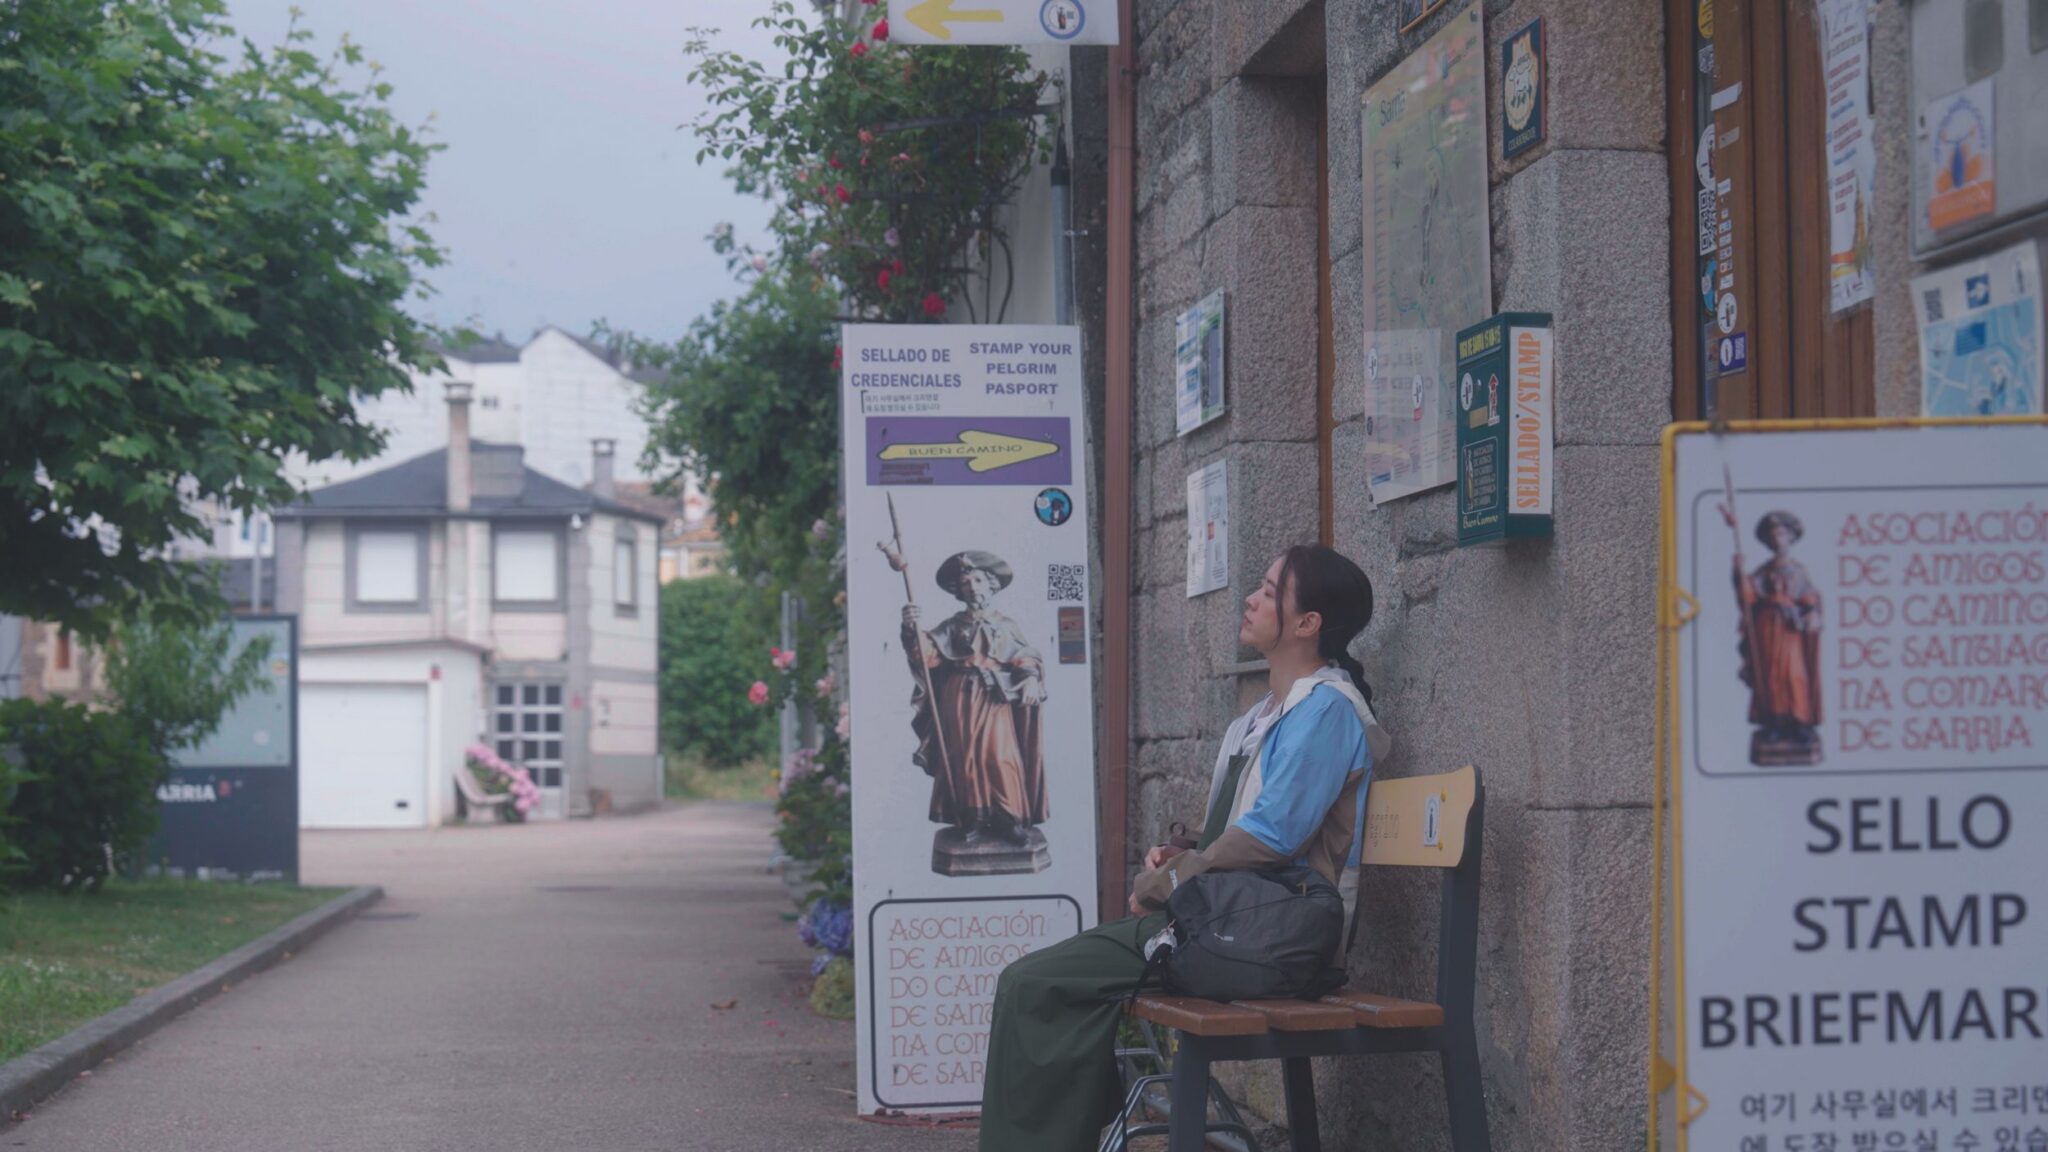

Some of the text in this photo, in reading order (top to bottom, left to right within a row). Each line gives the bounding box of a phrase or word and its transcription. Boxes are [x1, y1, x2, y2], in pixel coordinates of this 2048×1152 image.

[861, 348, 951, 363] SELLADO DE
[970, 342, 1072, 356] STAMP YOUR
[851, 373, 962, 389] CREDENCIALES
[986, 362, 1057, 375] PELGRIM
[985, 383, 1059, 395] PASPORT
[1516, 331, 1542, 509] SELLADO/STAMP
[908, 444, 1023, 456] BUEN CAMINO
[1838, 502, 2048, 546] ASOCIACIÓ
[1838, 550, 2045, 588] DE AMIGOS
[1838, 595, 1894, 629] DO
[1838, 636, 1890, 670] DE
[1903, 674, 2048, 712] COMAR
[1839, 714, 2032, 753] DE SARRIA
[1806, 794, 2012, 854] SELLO
[889, 909, 1046, 942] ASOCIACIÓN
[1793, 893, 2028, 953] STAMP
[889, 947, 925, 970] DE
[890, 973, 999, 999] DO CAM
[890, 1004, 927, 1028] DE
[892, 1064, 929, 1087] DE
[1741, 1091, 1796, 1123] 여기
[1811, 1086, 1957, 1120] 사무실에서
